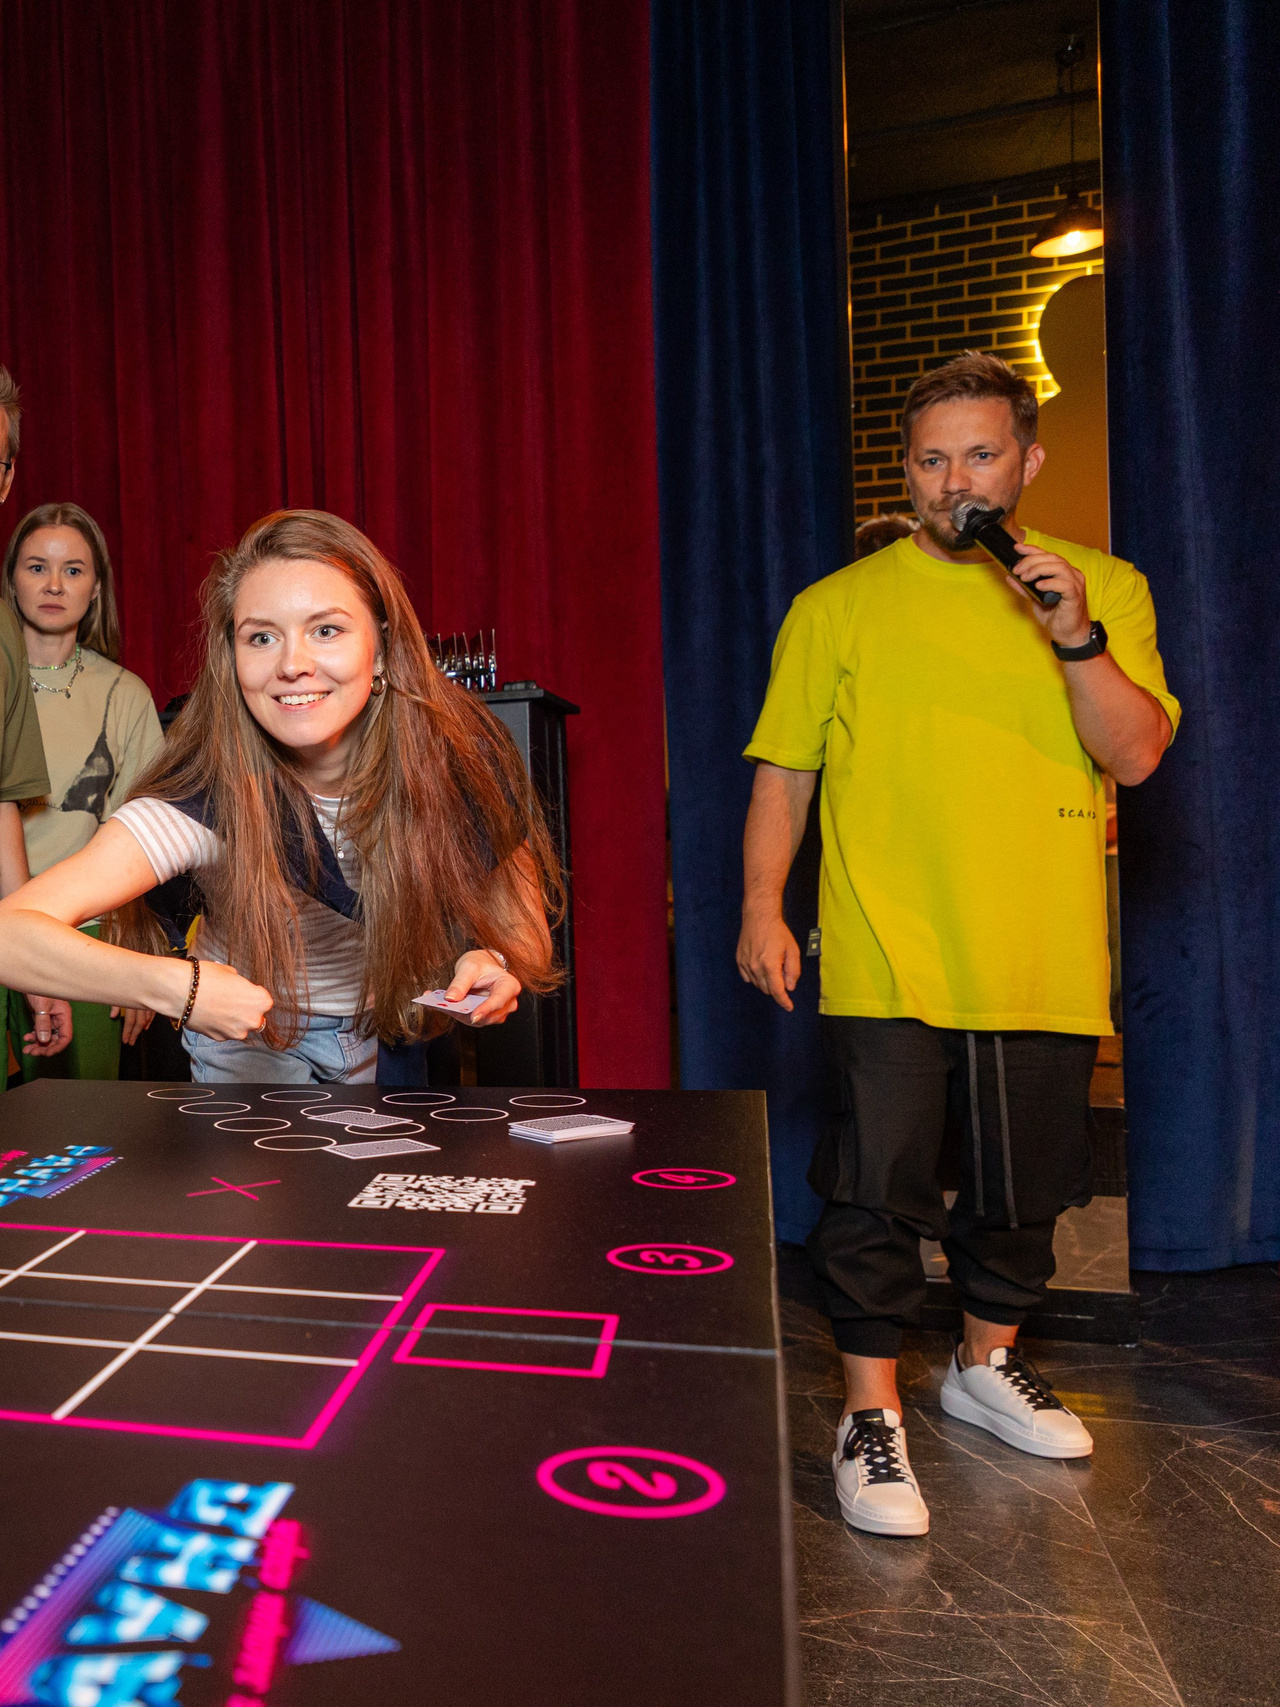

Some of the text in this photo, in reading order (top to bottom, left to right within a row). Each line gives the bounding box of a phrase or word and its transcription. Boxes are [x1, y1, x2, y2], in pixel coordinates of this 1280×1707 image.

[639, 1250, 703, 1269] 3
[586, 1460, 678, 1500] 2
[28, 1478, 296, 1707] АУНД
